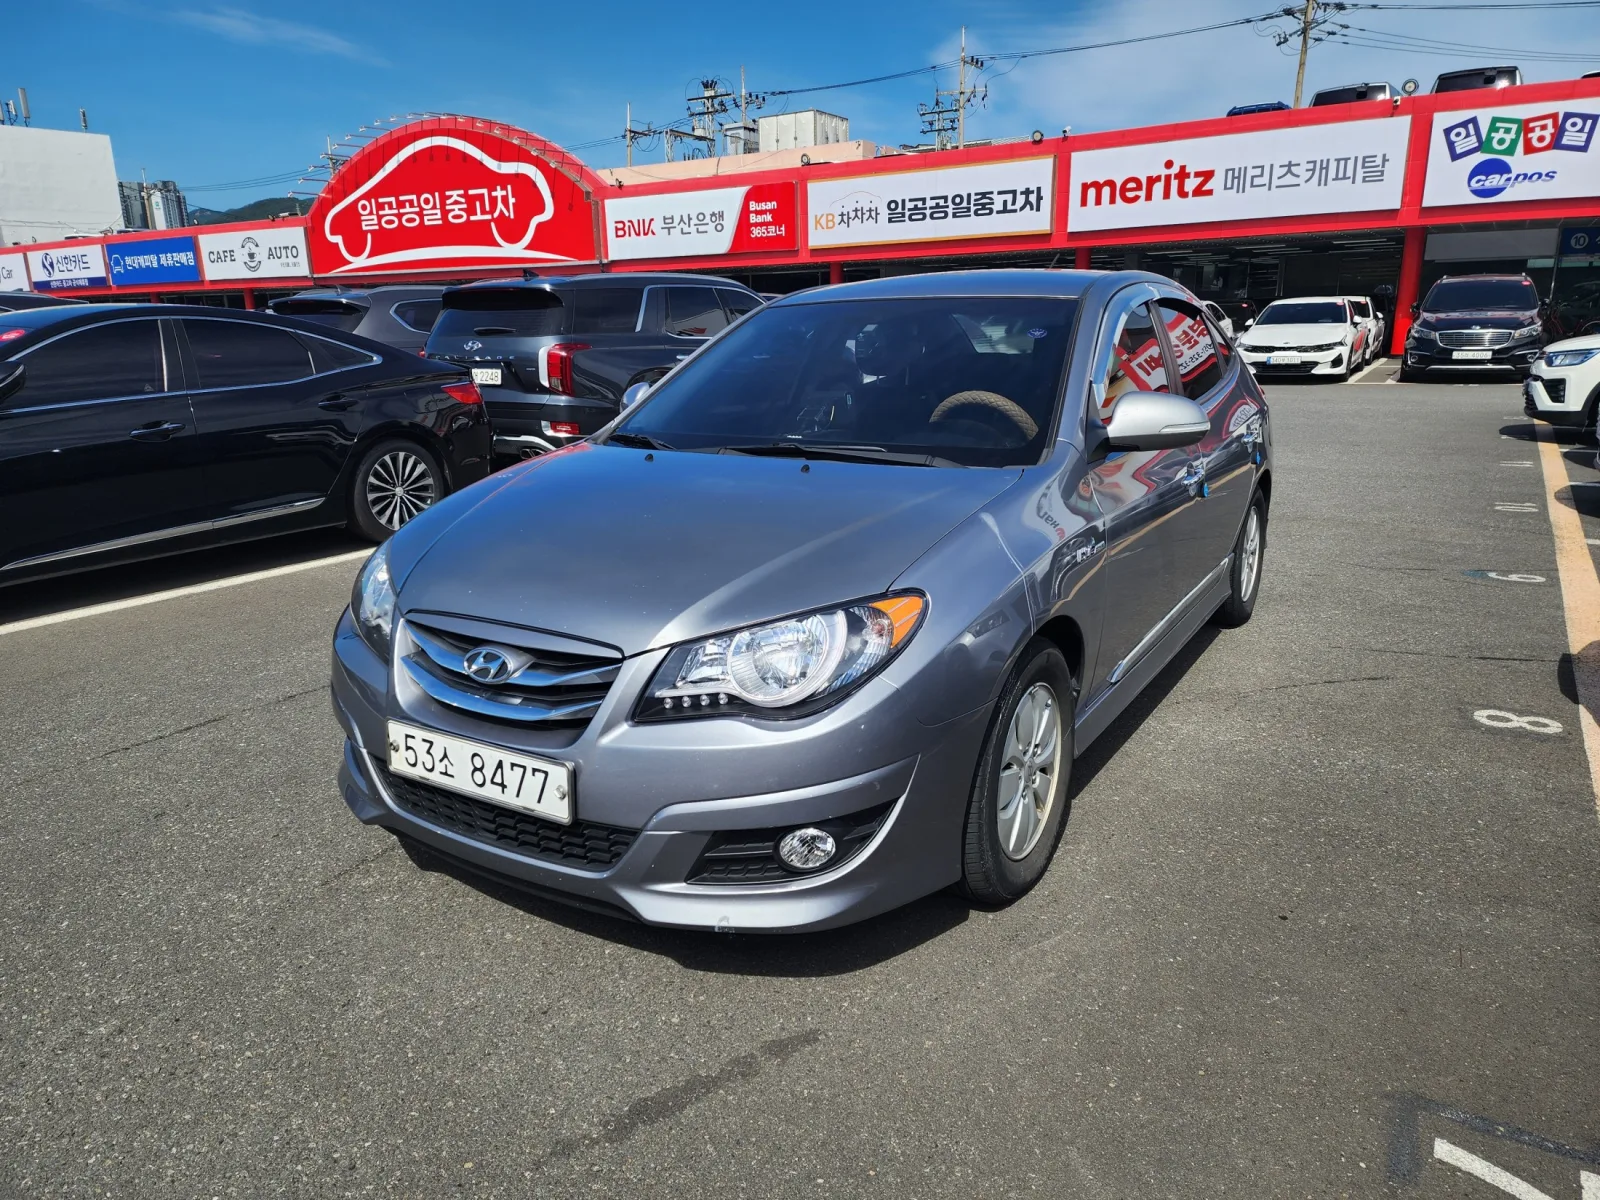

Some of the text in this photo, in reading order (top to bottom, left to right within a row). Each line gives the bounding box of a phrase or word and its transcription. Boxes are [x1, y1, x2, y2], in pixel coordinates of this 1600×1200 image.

[1450, 117, 1594, 155] 일공공일
[1080, 159, 1216, 208] meritz
[1223, 153, 1390, 194] 메리츠캐피탈
[1470, 170, 1557, 188] carpos
[358, 185, 516, 231] 일공공일 중고차
[749, 200, 778, 211] Busan
[886, 186, 1044, 224] 일공공일중고차
[614, 210, 725, 239] BNK 부산은행
[749, 212, 773, 223] Bank
[750, 223, 786, 238] 365코너
[55, 252, 91, 274] 신한카드
[208, 245, 299, 264] CAFE AUTO
[1, 266, 13, 280] Car
[479, 370, 499, 383] 2248
[404, 733, 549, 804] 53소 8477
